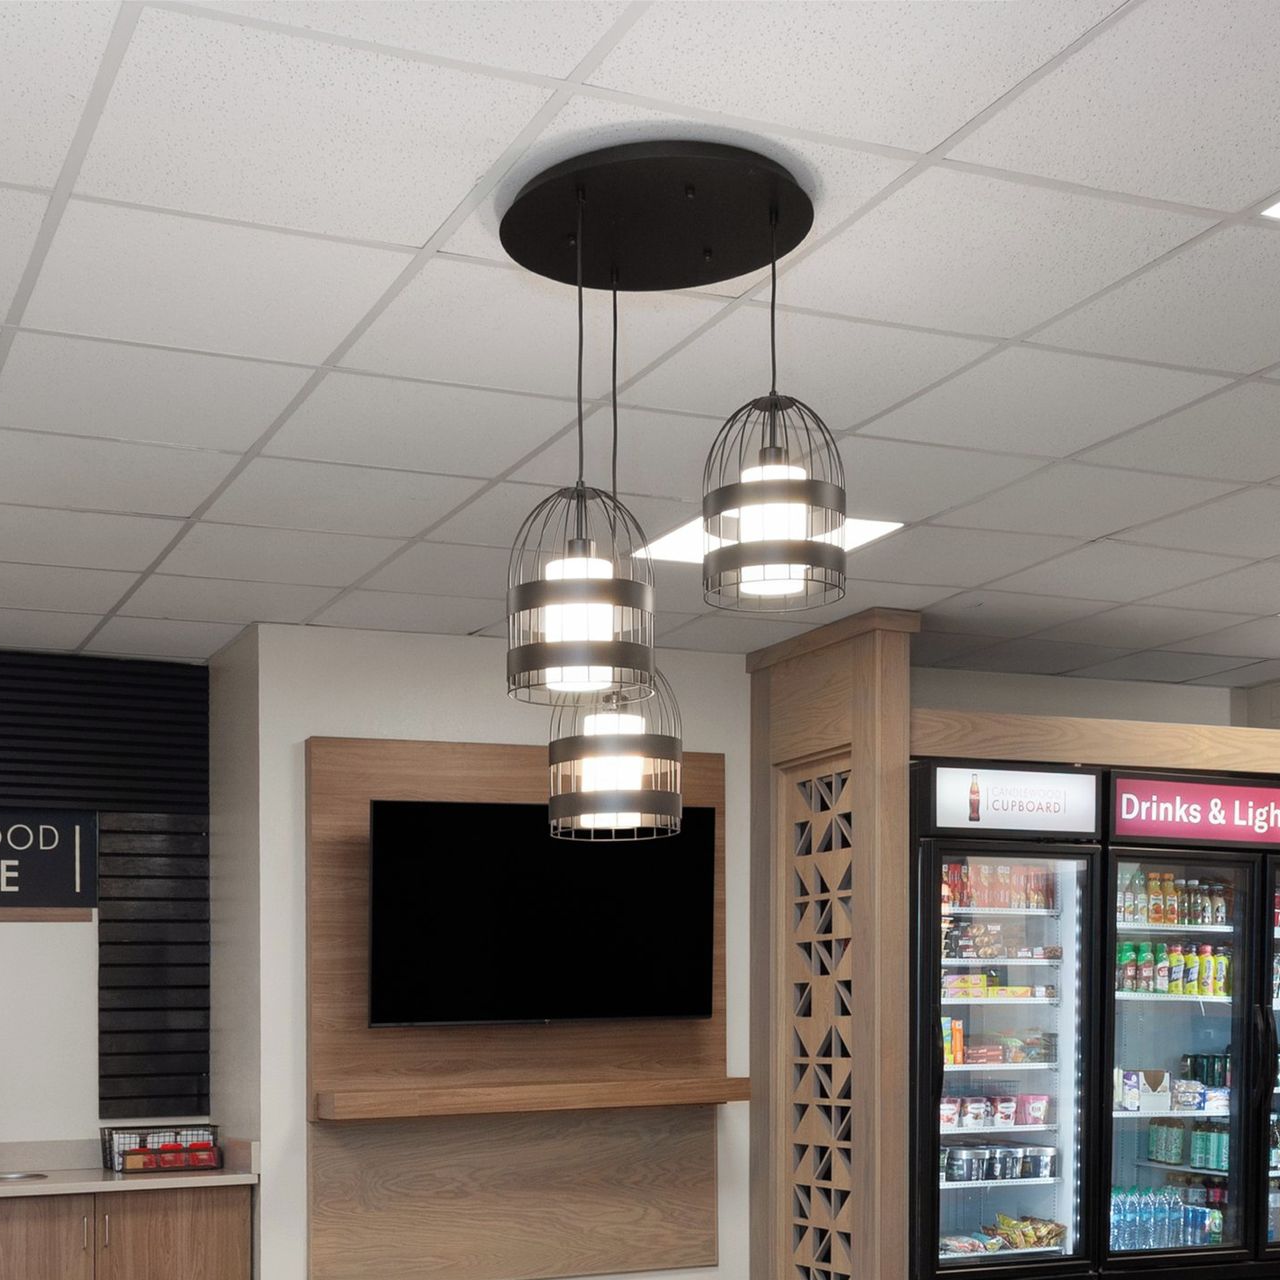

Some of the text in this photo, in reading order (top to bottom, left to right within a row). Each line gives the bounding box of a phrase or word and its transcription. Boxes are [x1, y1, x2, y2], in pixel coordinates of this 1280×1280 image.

[991, 785, 1062, 801] CANDLEWOOD
[991, 799, 1061, 814] CUPBOARD
[1121, 793, 1201, 824] Drinks
[1208, 798, 1226, 825] &
